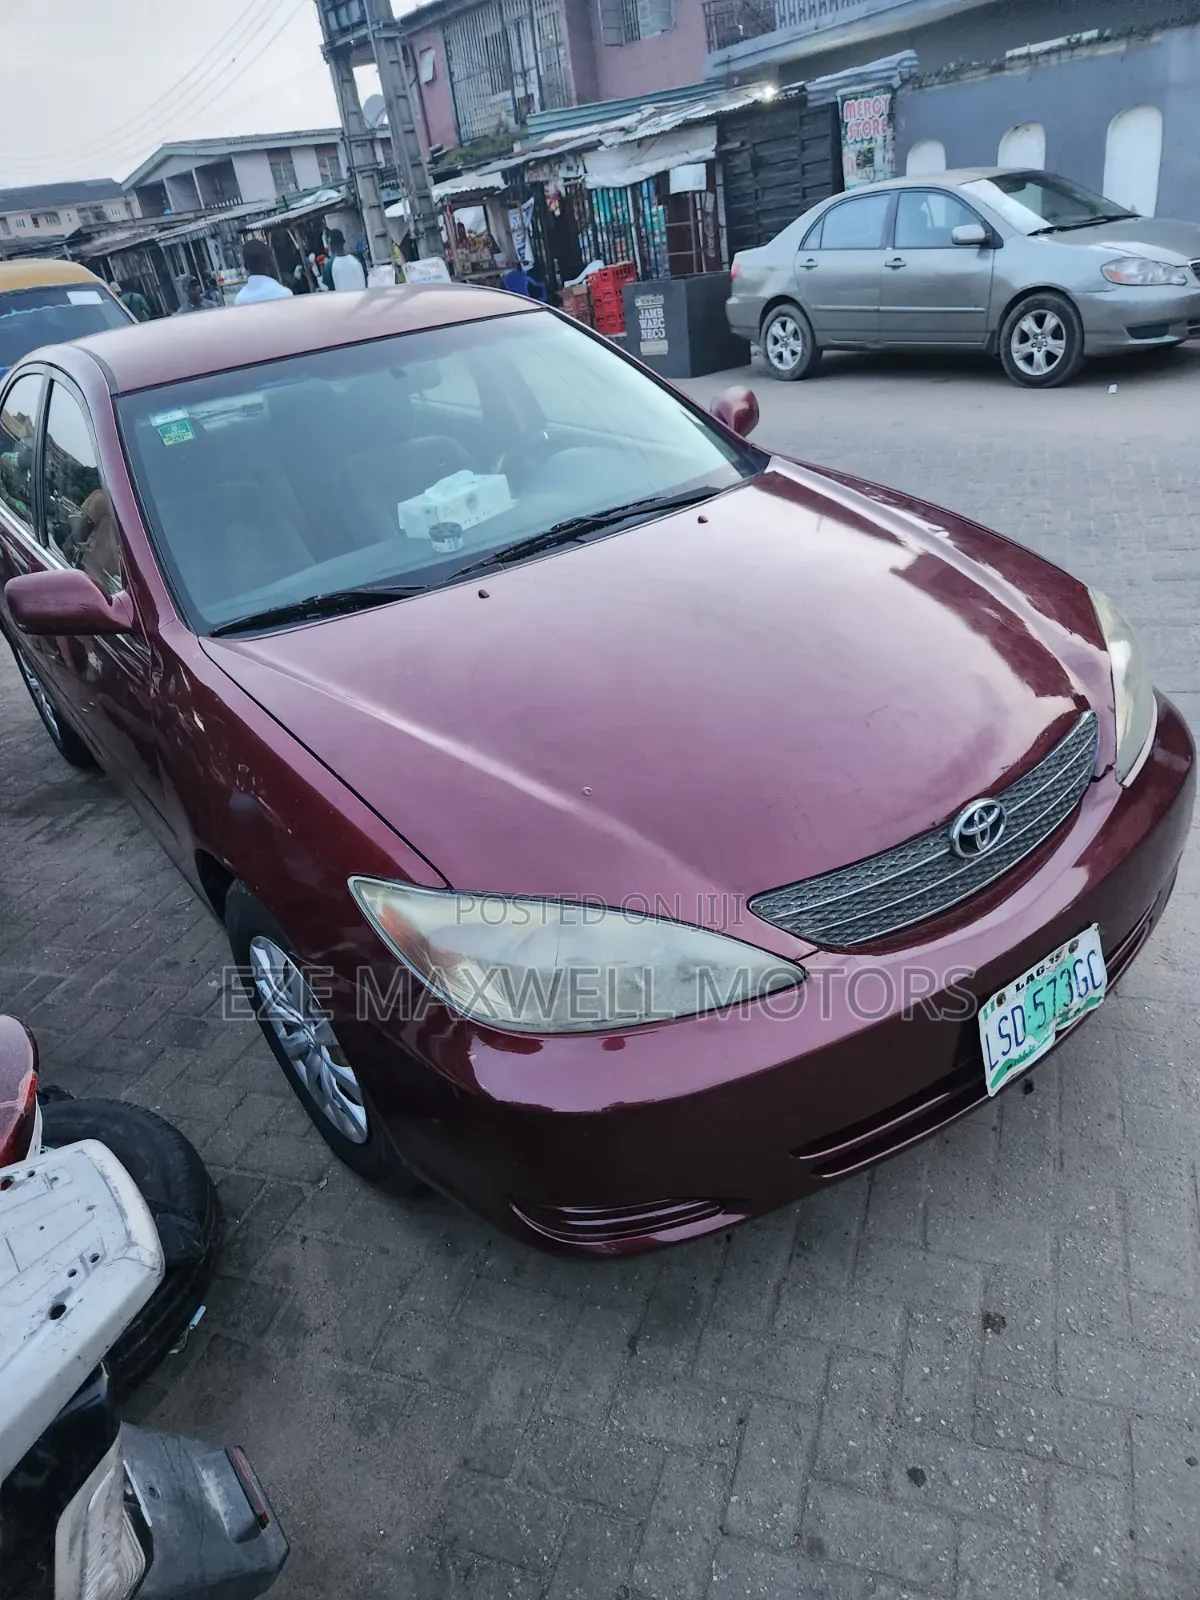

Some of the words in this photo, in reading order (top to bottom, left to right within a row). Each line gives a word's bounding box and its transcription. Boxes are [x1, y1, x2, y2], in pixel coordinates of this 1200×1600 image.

[847, 115, 888, 143] STORE
[638, 308, 664, 319] JAMB
[638, 318, 665, 329] WAEC
[640, 328, 666, 339] NECO
